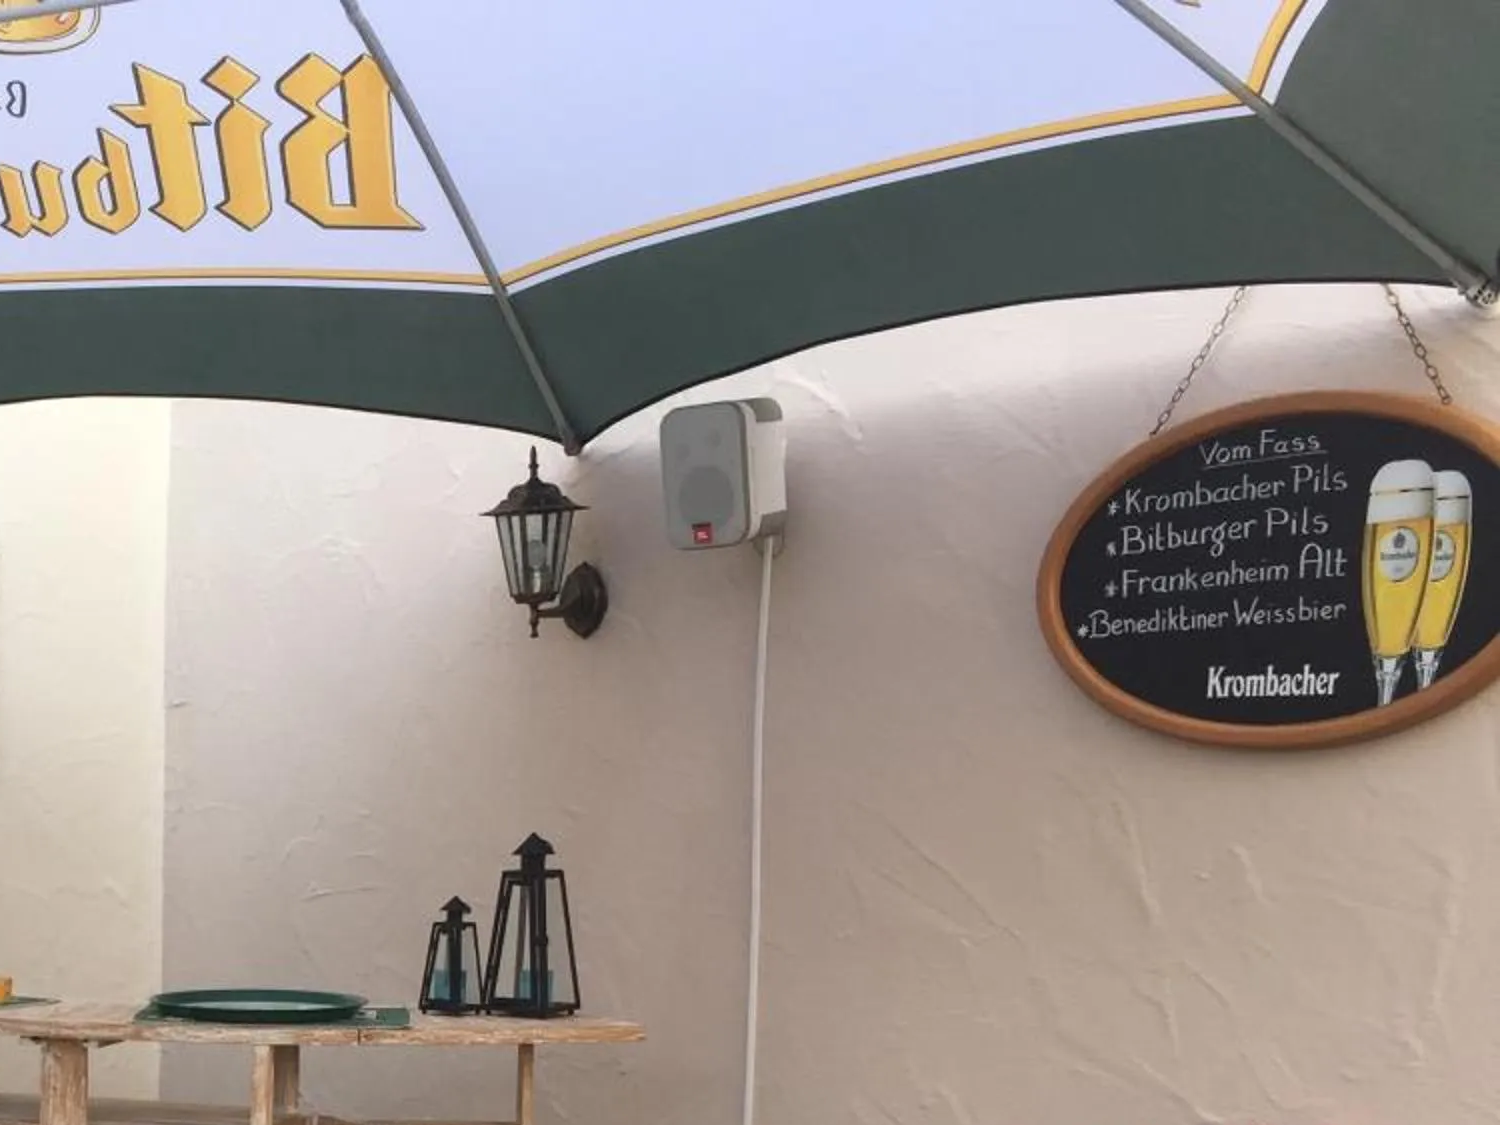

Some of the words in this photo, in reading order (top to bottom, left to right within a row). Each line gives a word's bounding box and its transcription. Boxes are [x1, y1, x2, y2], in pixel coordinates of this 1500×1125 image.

[1201, 442, 1252, 465] Vom
[1259, 429, 1321, 456] Fass
[1124, 473, 1286, 515] Krombacher
[1290, 463, 1349, 494] Pils
[1121, 519, 1258, 558] Bitburger
[1265, 506, 1330, 538] Pils
[1121, 558, 1290, 599] Frankenheim
[1299, 542, 1348, 579] Alt
[1088, 604, 1229, 639] Benediktiner
[1233, 596, 1348, 626] Weissbier
[1206, 663, 1341, 699] Krombacher
